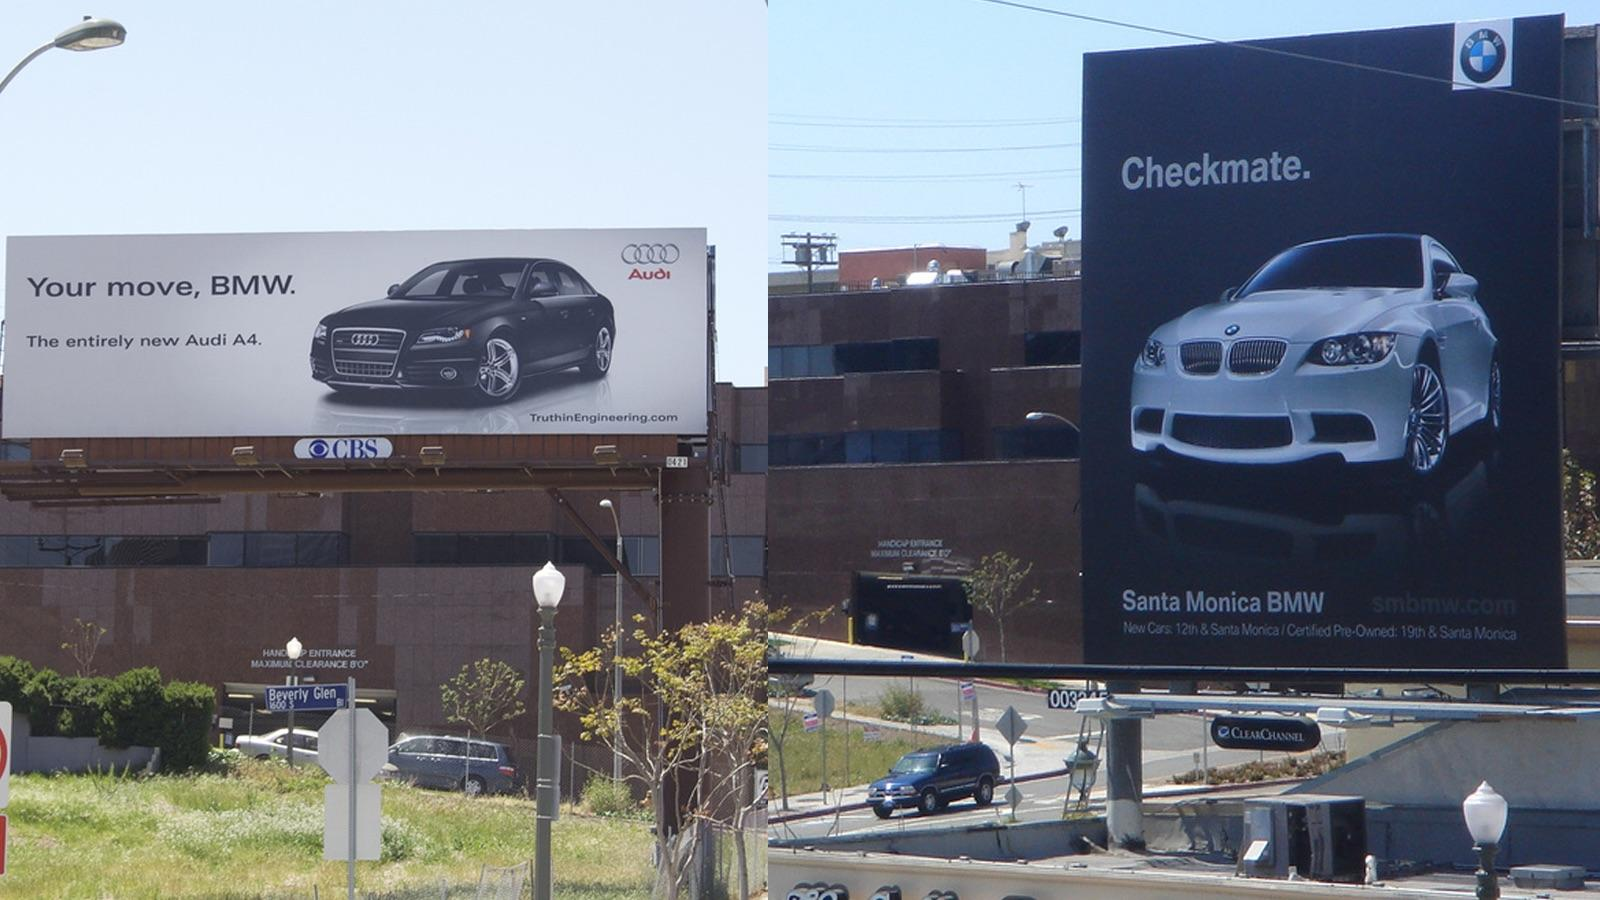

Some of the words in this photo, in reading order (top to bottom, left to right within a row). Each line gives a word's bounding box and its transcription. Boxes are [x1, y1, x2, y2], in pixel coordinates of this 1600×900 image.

[1121, 151, 1311, 190] Checkmate.
[628, 268, 670, 280] Audi
[27, 277, 96, 297] Your
[108, 280, 200, 299] move,
[211, 275, 295, 295] BMW.
[26, 335, 59, 348] The
[66, 334, 134, 350] entirely
[141, 336, 180, 347] new
[185, 333, 227, 346] Audi
[232, 333, 262, 346] A4.
[529, 412, 679, 424] TruthinEngineering.com
[333, 439, 378, 459] CBS
[1122, 589, 1181, 612] Santa
[1186, 590, 1262, 613] Monica
[1267, 591, 1324, 613] BMW
[1373, 591, 1516, 615] smbmw.com
[1123, 622, 1146, 634] New
[1147, 622, 1172, 635] Cars:
[1176, 622, 1198, 635] 12th
[1200, 623, 1209, 635] &
[1210, 623, 1240, 636] Santa
[1242, 623, 1279, 637] Monica
[1287, 624, 1332, 637] Certified
[1333, 624, 1399, 638] Pre-Owned:
[1402, 625, 1425, 638] 19th
[1428, 626, 1437, 638] &
[1440, 626, 1472, 639] Santa
[1474, 626, 1517, 640] Monica
[309, 649, 356, 657] ENTRANCE
[294, 660, 348, 668] CLEARANCE
[269, 688, 309, 703] Beverly
[313, 687, 337, 700] Glen
[269, 701, 287, 710] 1600
